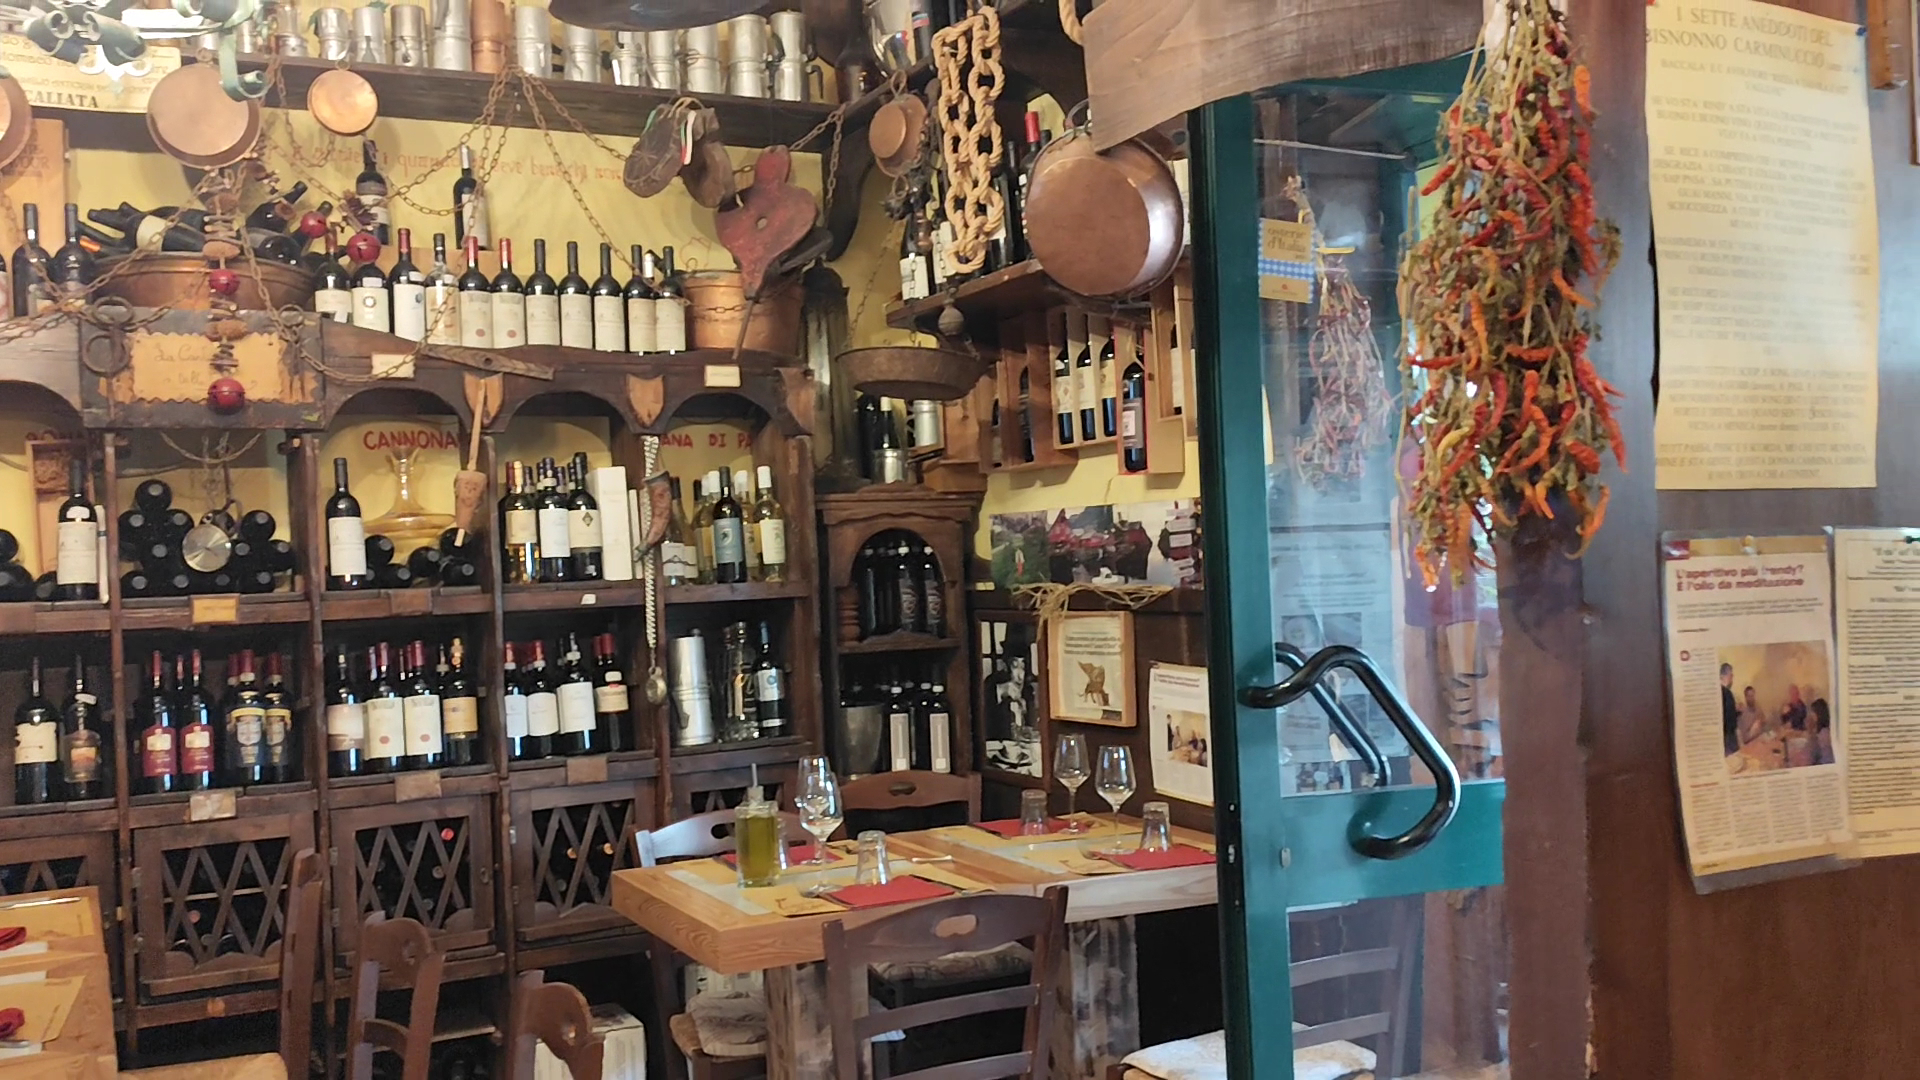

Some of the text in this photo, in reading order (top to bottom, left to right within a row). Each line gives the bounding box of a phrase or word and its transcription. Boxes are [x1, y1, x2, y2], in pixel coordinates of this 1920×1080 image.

[1690, 7, 1738, 28] SETTE
[1741, 15, 1808, 43] ANEDDOTI
[1810, 28, 1834, 47] DEL
[1646, 27, 1728, 50] BISNONNO
[1733, 36, 1826, 69] CARMINUCCIO
[708, 433, 727, 448] DI
[1717, 580, 1732, 590] da
[1735, 578, 1805, 589] meditazione
